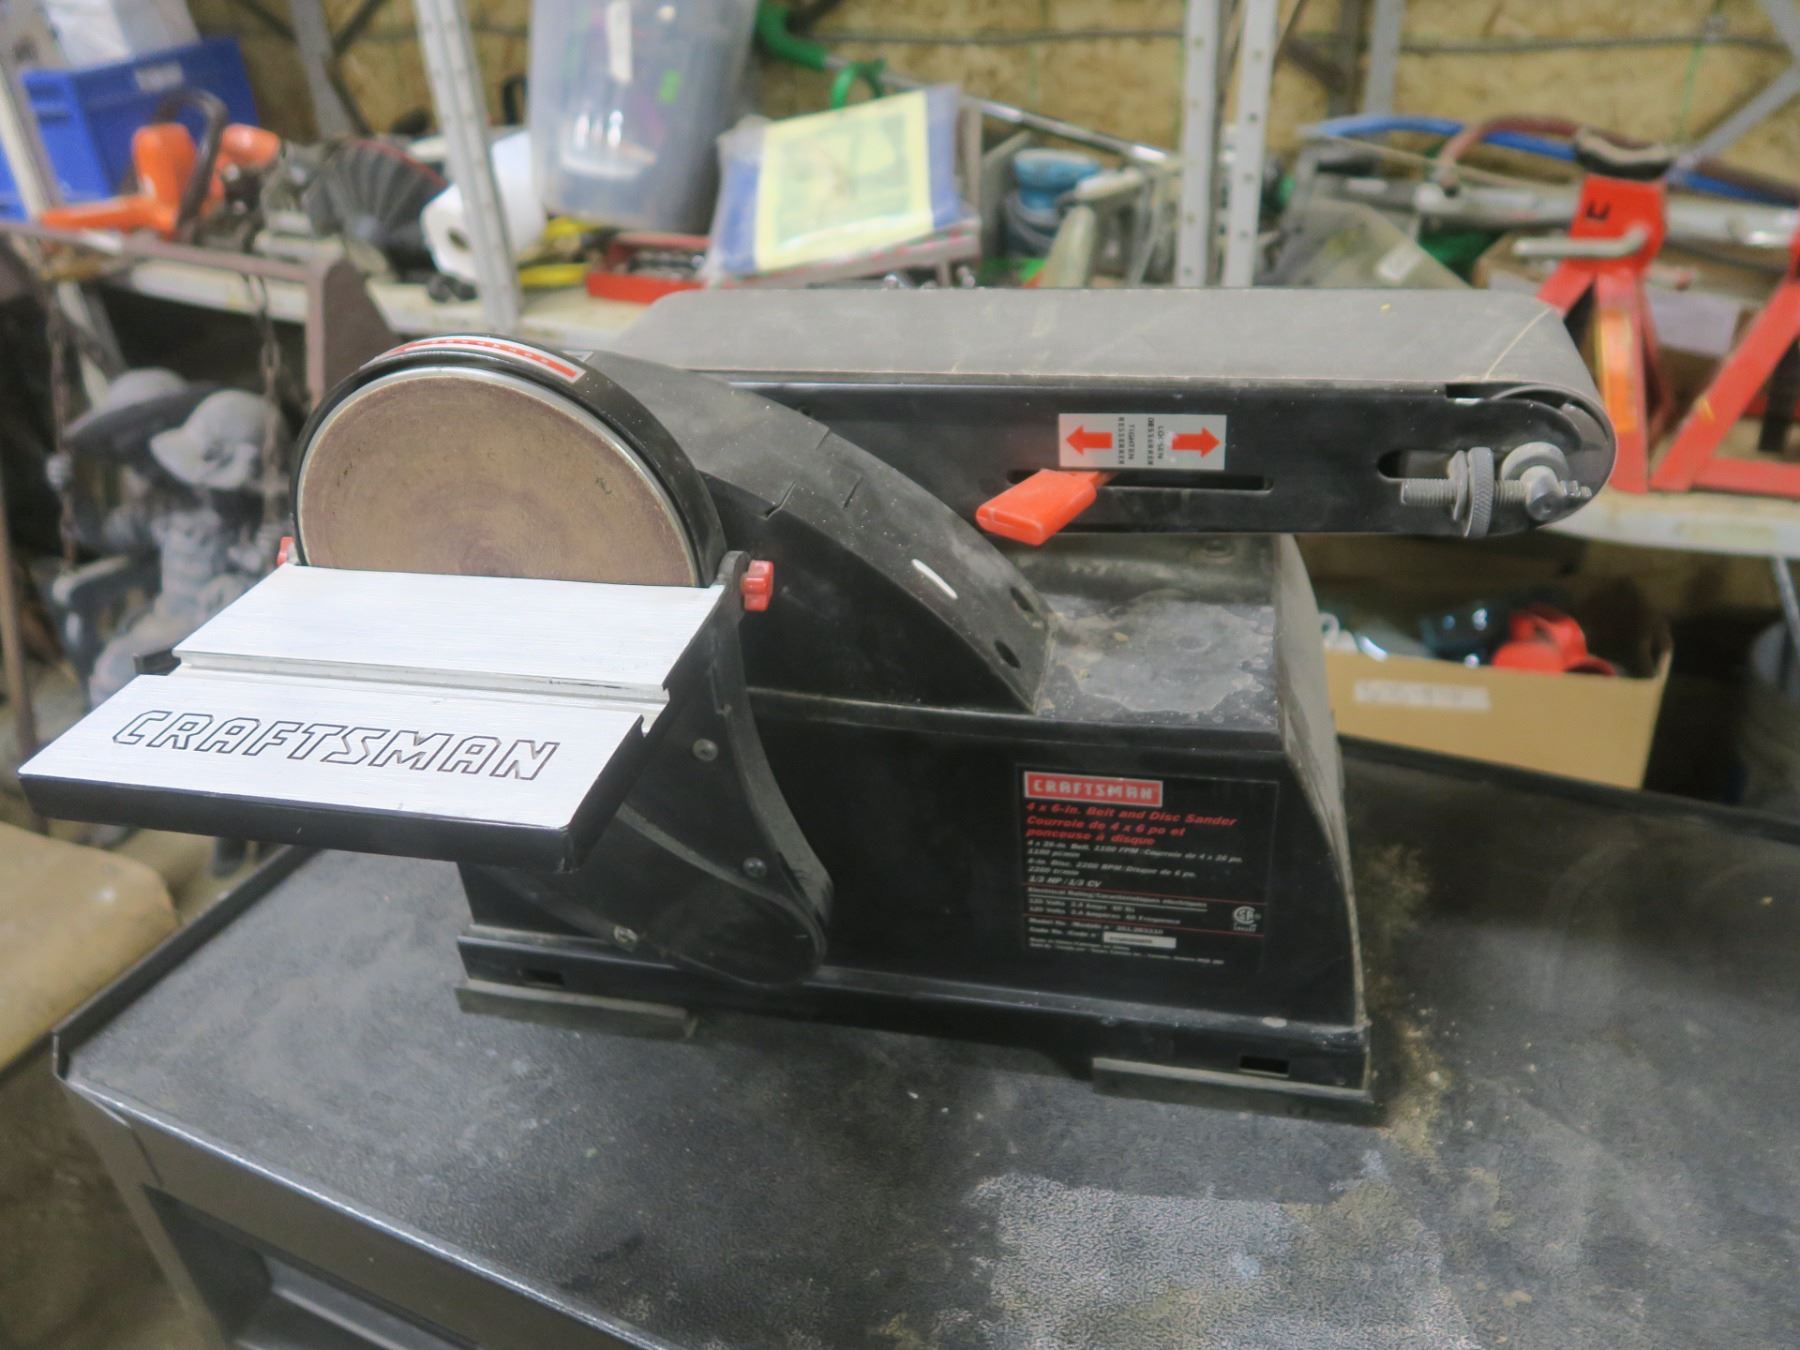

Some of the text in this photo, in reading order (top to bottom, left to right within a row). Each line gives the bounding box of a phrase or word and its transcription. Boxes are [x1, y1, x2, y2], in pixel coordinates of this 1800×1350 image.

[112, 709, 560, 781] CRAFTSMAN
[1033, 779, 1153, 800] CRAFTSMAN
[1026, 803, 1036, 811] 4
[1039, 804, 1048, 812] x
[1086, 806, 1116, 816] Belt
[1118, 810, 1146, 819] and
[1149, 811, 1181, 822] Disc
[1184, 814, 1238, 826] Sander
[1027, 815, 1085, 828] Courroie
[1088, 820, 1106, 830] de
[1110, 822, 1120, 831] 4
[1135, 824, 1146, 834] 6
[1147, 826, 1166, 836] po
[1170, 826, 1187, 836] et
[1026, 828, 1092, 840] ponceuse
[1110, 834, 1156, 846] disque
[1086, 880, 1103, 888] CV
